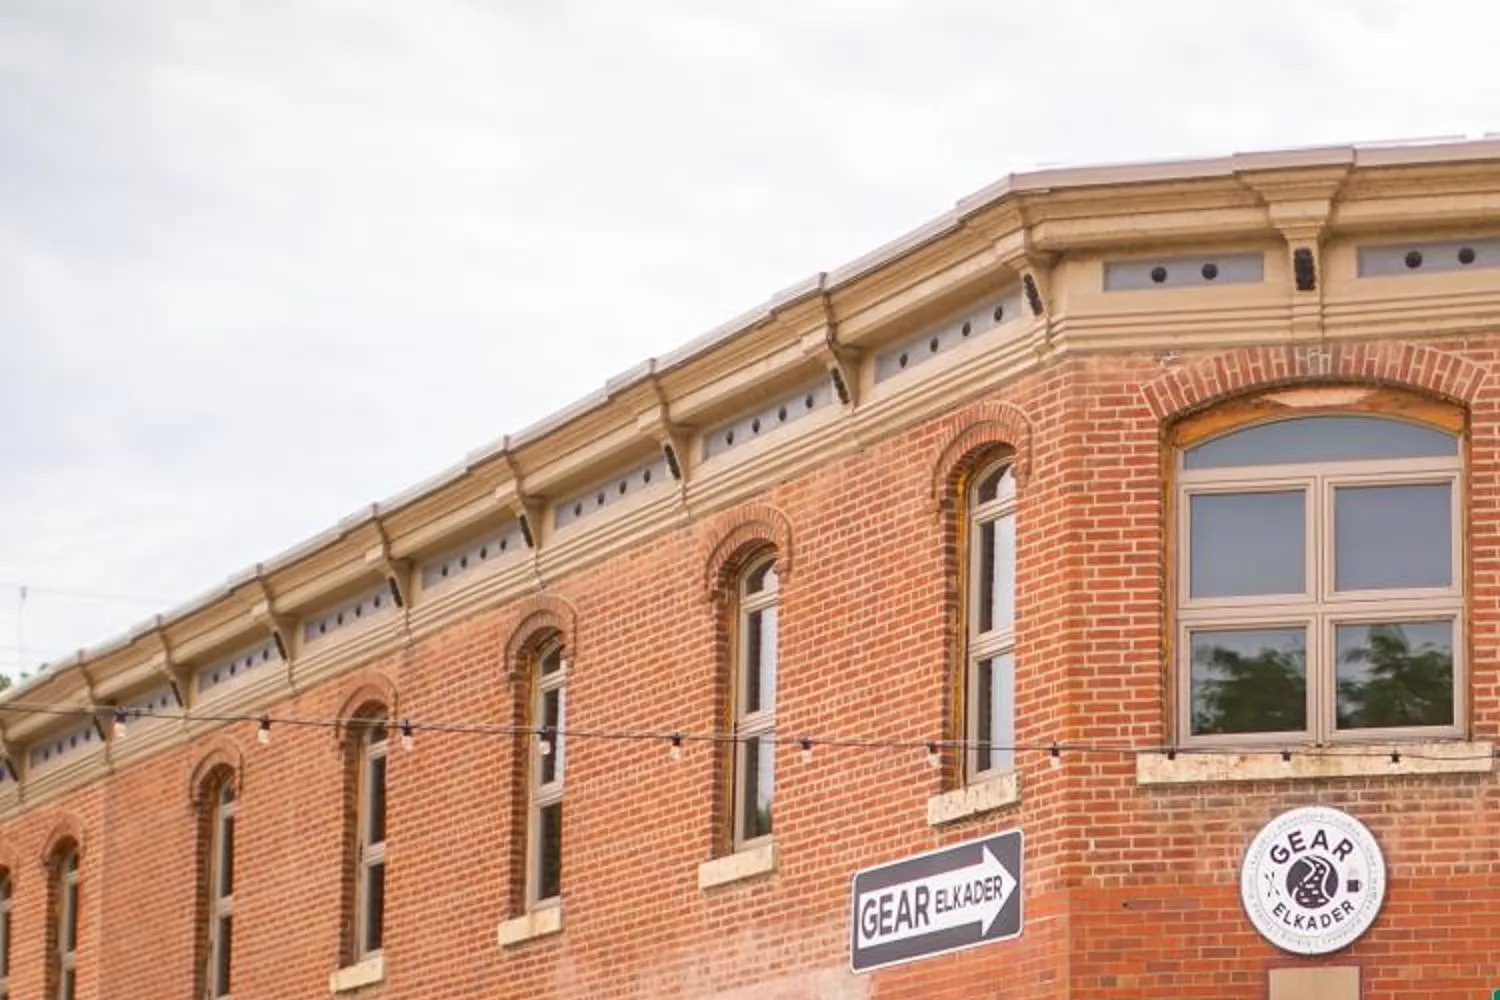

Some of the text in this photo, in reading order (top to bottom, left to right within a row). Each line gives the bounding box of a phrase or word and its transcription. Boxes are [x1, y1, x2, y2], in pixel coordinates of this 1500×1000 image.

[1270, 829, 1354, 865] GEAR
[861, 875, 1003, 940] GEAR ELKADER
[1272, 900, 1355, 932] ELKADER
